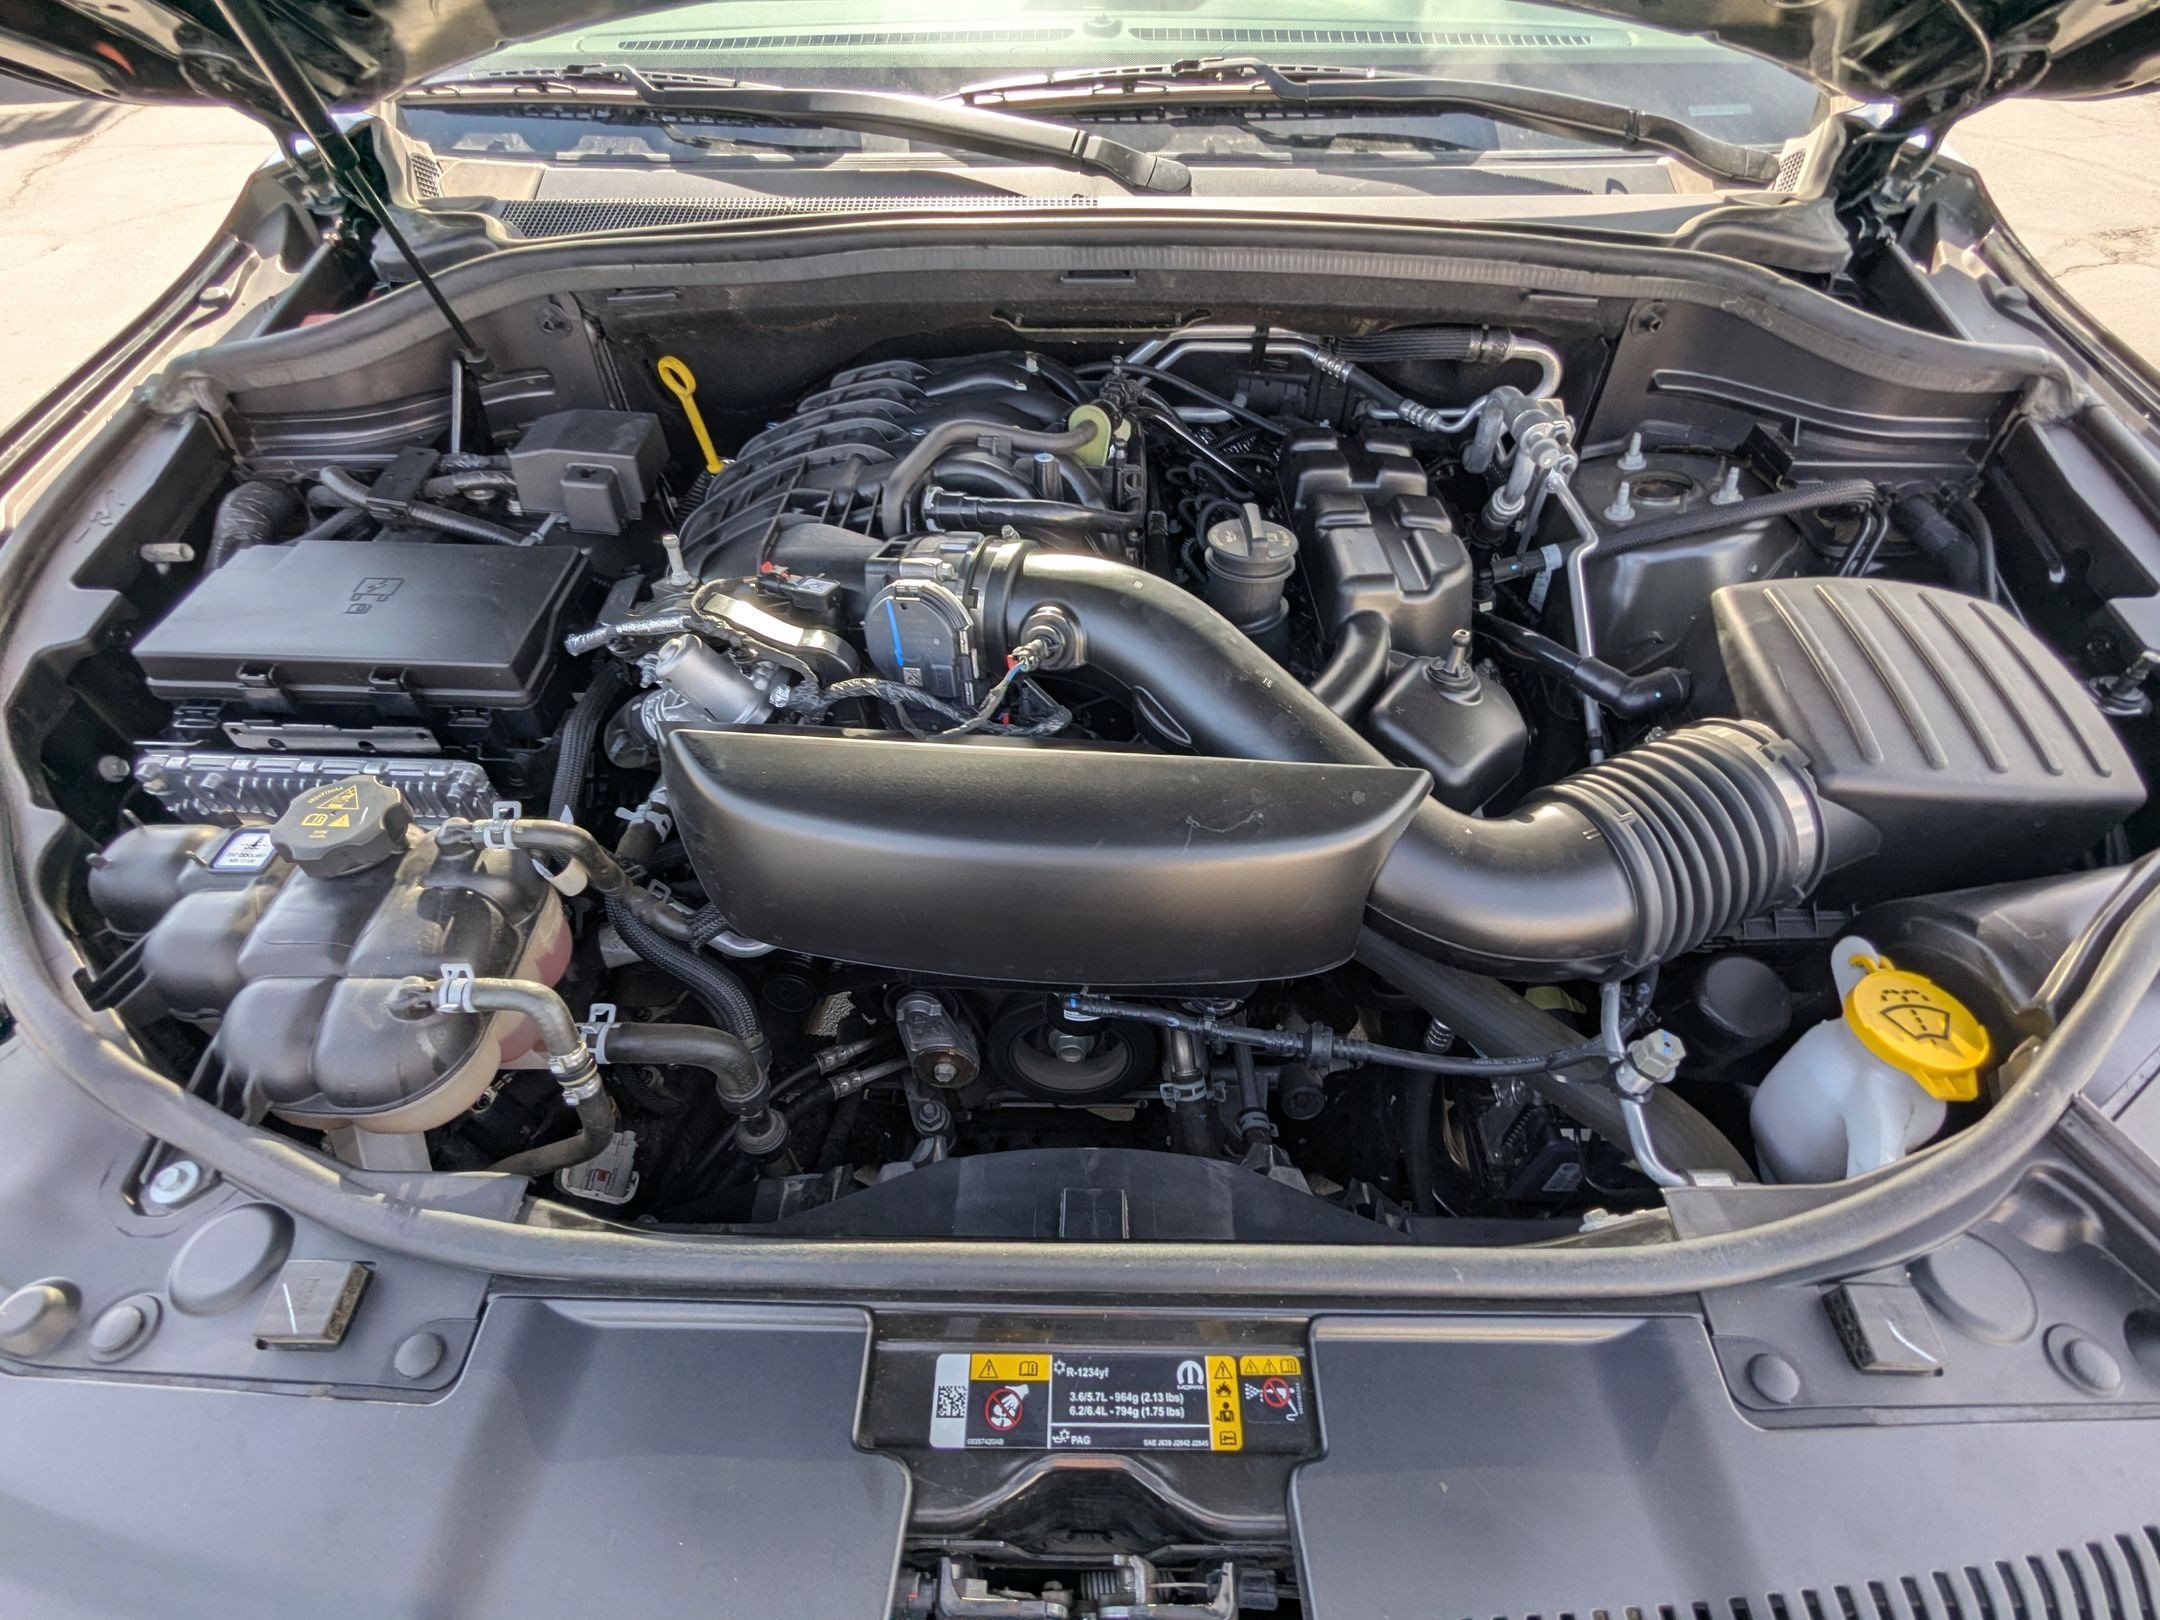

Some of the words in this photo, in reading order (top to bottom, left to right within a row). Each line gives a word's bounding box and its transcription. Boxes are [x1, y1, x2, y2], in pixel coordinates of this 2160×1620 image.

[1066, 1367, 1109, 1380] R-1234yf
[1069, 1392, 1108, 1402] 3.6/5.7L
[1115, 1392, 1139, 1405] 964g
[1141, 1392, 1164, 1405] (2.13
[1166, 1392, 1184, 1405] lbs)
[1069, 1405, 1108, 1416] 6.2/6.4L
[1115, 1406, 1139, 1419] 794g
[1141, 1406, 1164, 1419] (1.75
[1166, 1406, 1185, 1419] lbs)
[1071, 1435, 1091, 1445] PAG
[1144, 1439, 1157, 1447] SAE
